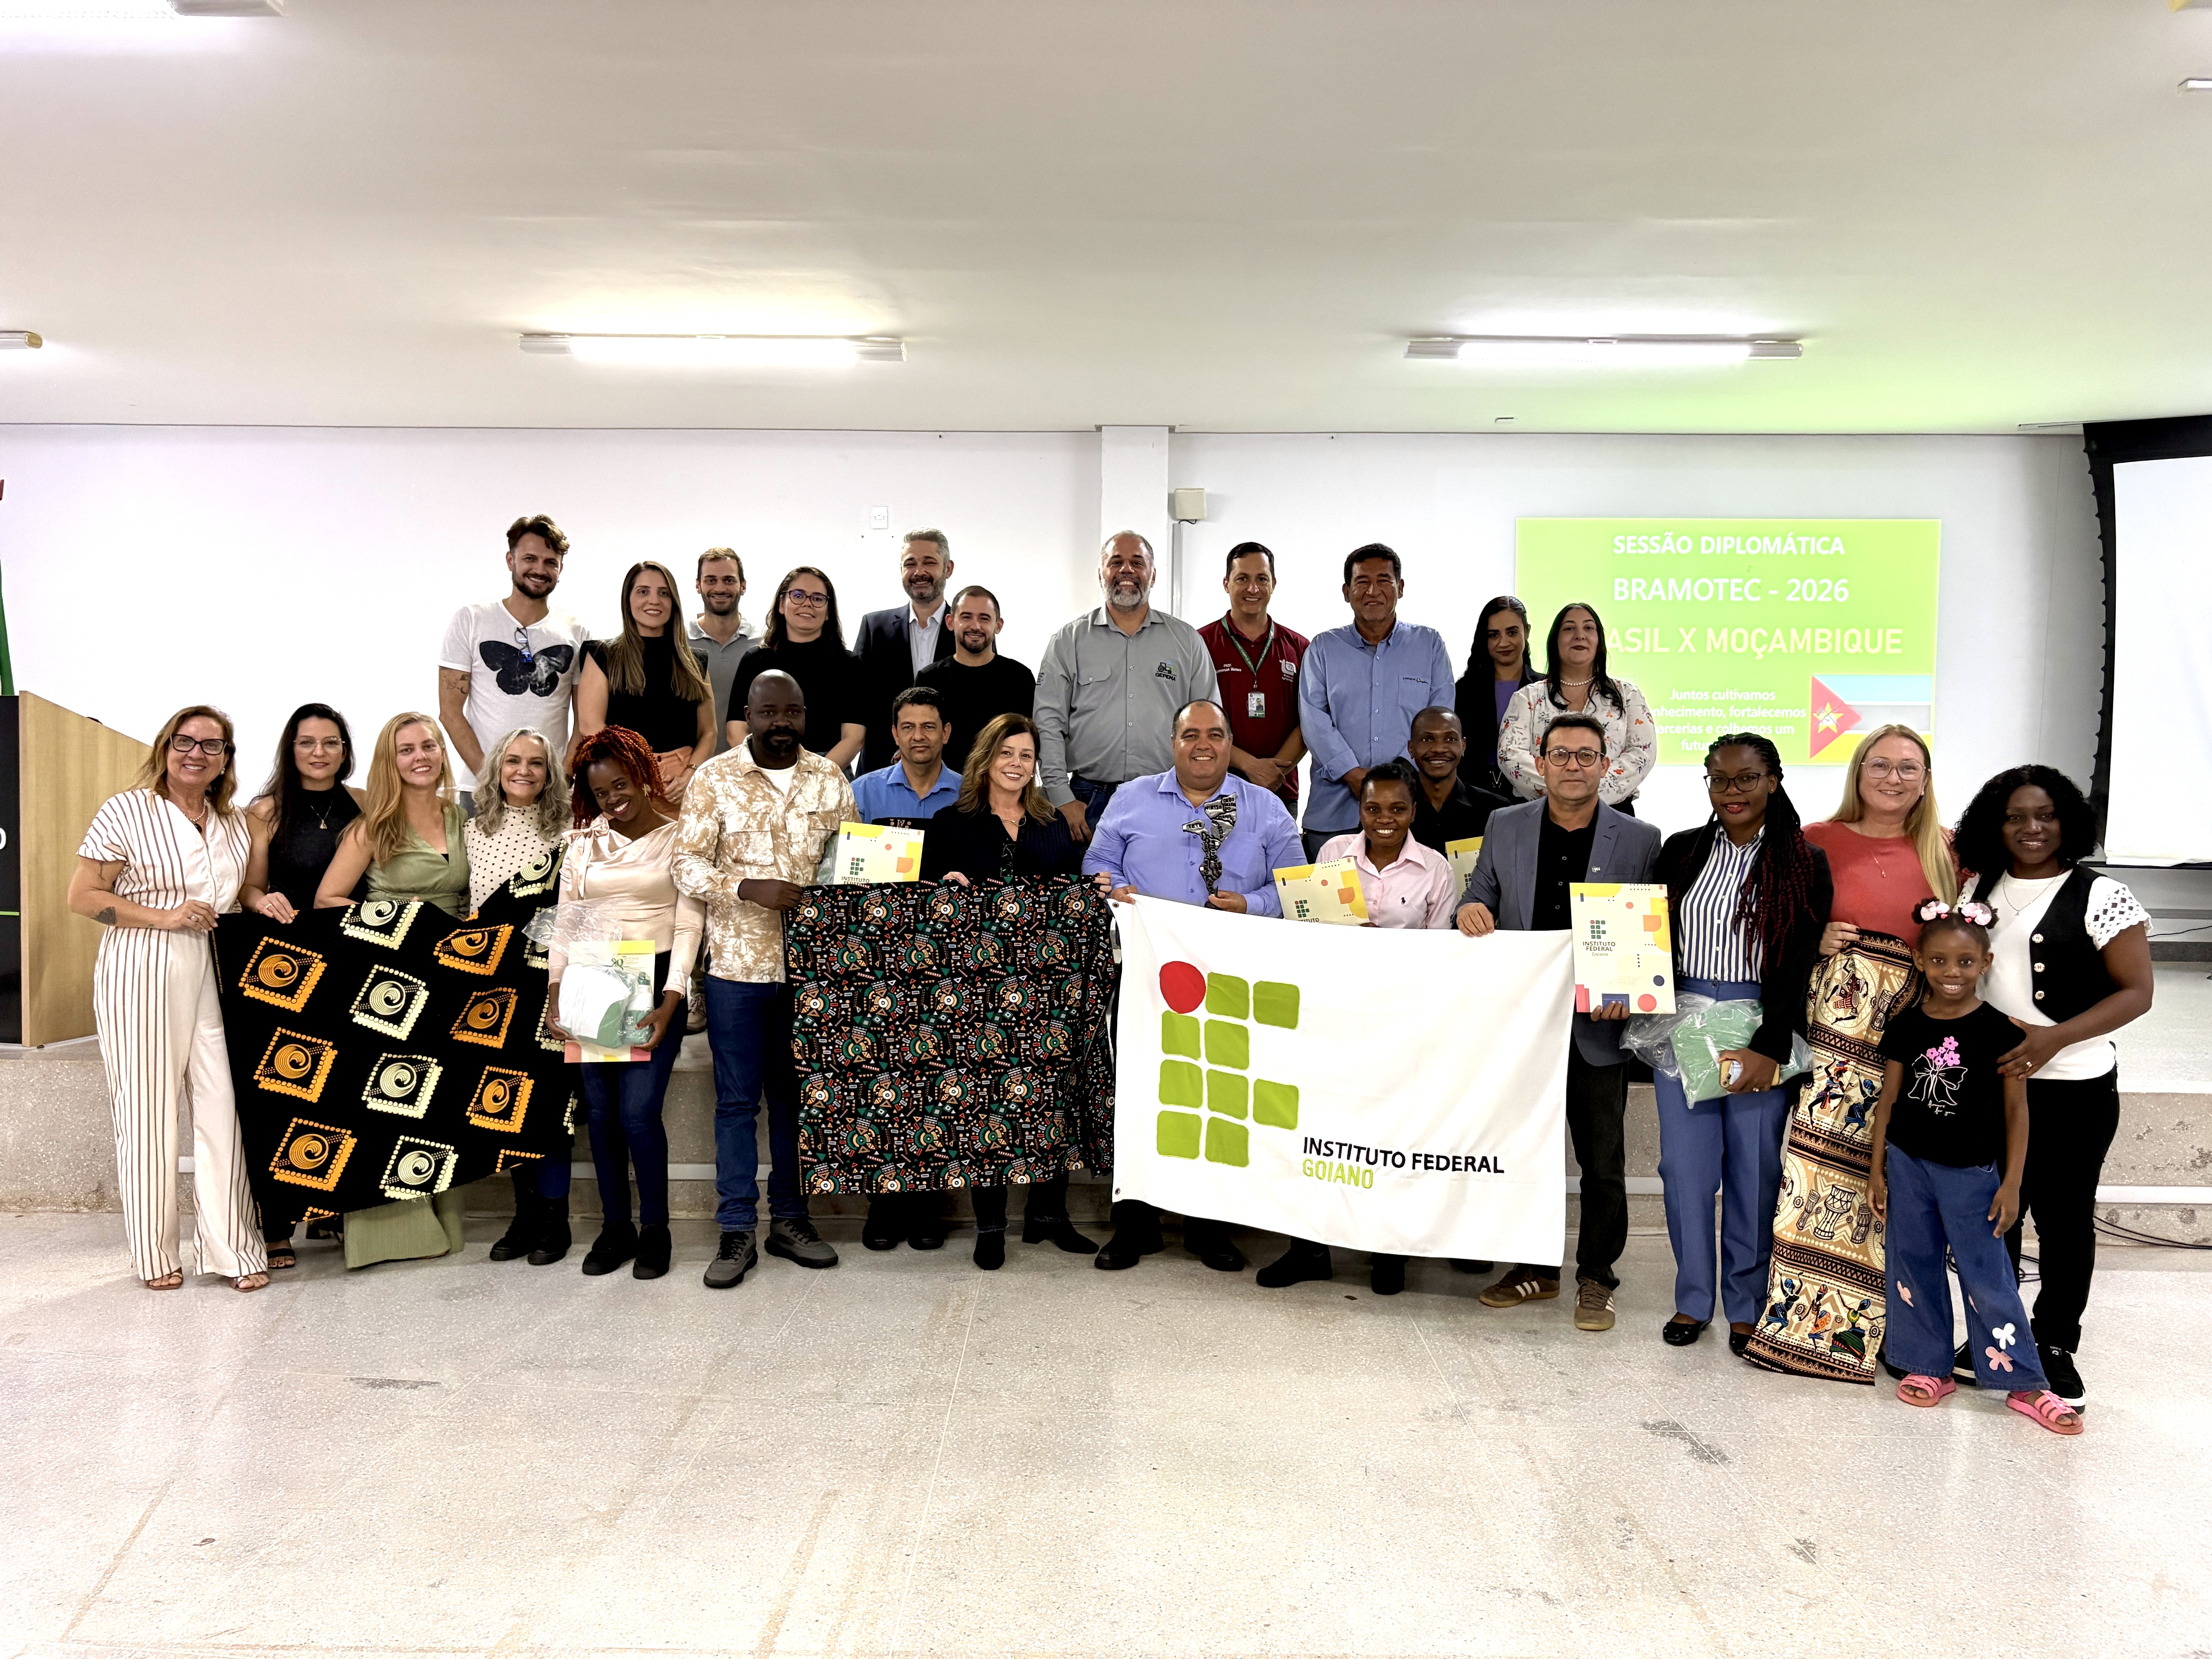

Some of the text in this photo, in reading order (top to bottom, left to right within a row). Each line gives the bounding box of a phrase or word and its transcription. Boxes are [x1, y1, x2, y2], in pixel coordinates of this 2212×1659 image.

[1613, 531, 1845, 555] SESSÃO DIPLOMÁTICA
[1613, 578, 1760, 601] BRAMOTEC
[1786, 578, 1849, 602] 2026
[1607, 627, 1903, 659] ASIL X MOÇAMBIQUE
[1670, 688, 1776, 701] Juntos cultivamos
[1729, 705, 1807, 718] fortalecemos
[1656, 722, 1795, 735] arcerias e colhemos um
[1303, 1137, 1504, 1173] INSTITUTO FEDERAL
[1302, 1158, 1374, 1189] GOIANO
